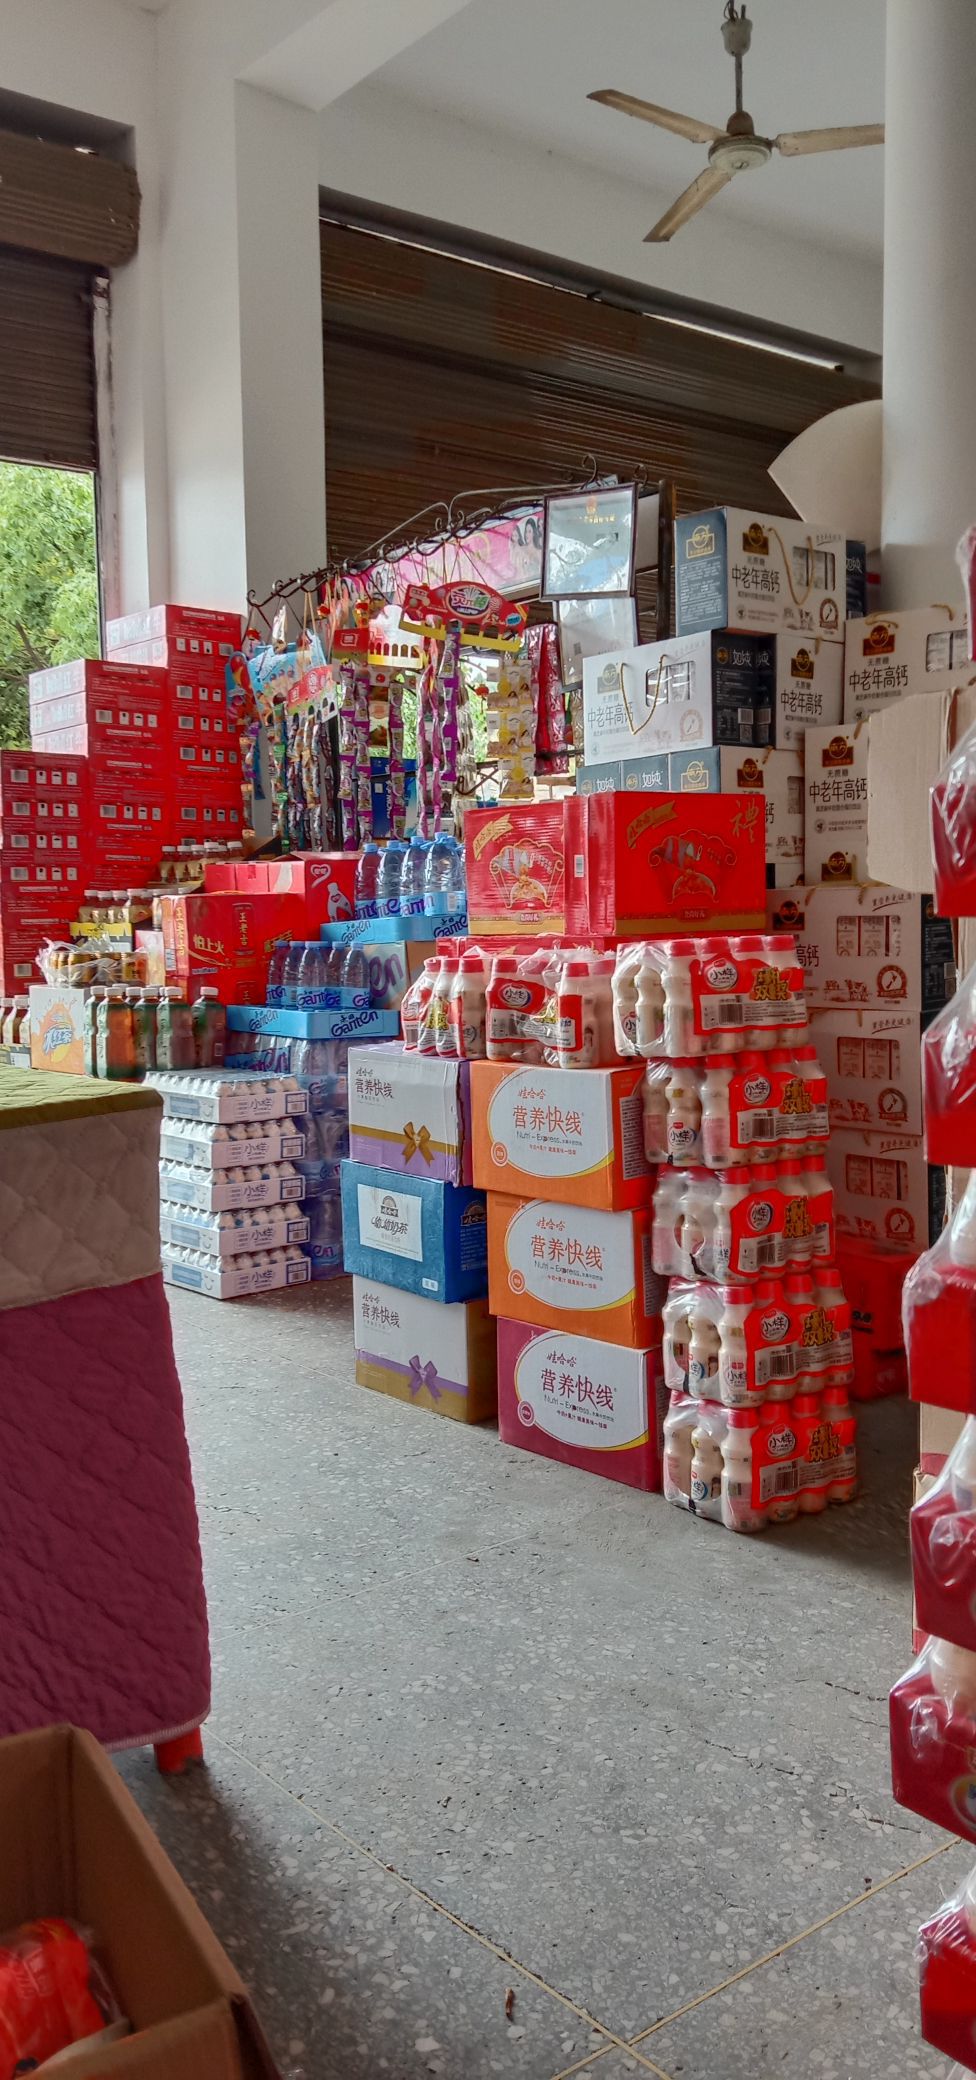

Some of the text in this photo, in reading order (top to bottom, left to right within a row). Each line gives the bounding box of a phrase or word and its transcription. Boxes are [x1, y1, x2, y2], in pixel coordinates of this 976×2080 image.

[731, 564, 780, 593] 中老年高钙
[849, 665, 908, 692] 中老年高钙
[588, 701, 634, 728] 中老年高钙
[780, 690, 823, 716] 中老年高钙
[809, 778, 868, 803] 中老年高钙
[193, 934, 225, 955] 怕上火
[331, 1010, 378, 1037] Ganten
[355, 1079, 394, 1099] 营养快线
[518, 1086, 546, 1099] 娃哈哈
[513, 1104, 582, 1138] 营养快线
[536, 1217, 565, 1231] 娃哈哈
[531, 1235, 603, 1271] 营养快线
[361, 1302, 401, 1328] 营养快线
[546, 1350, 577, 1367] 娃哈哈
[541, 1368, 614, 1411] 营养快线
